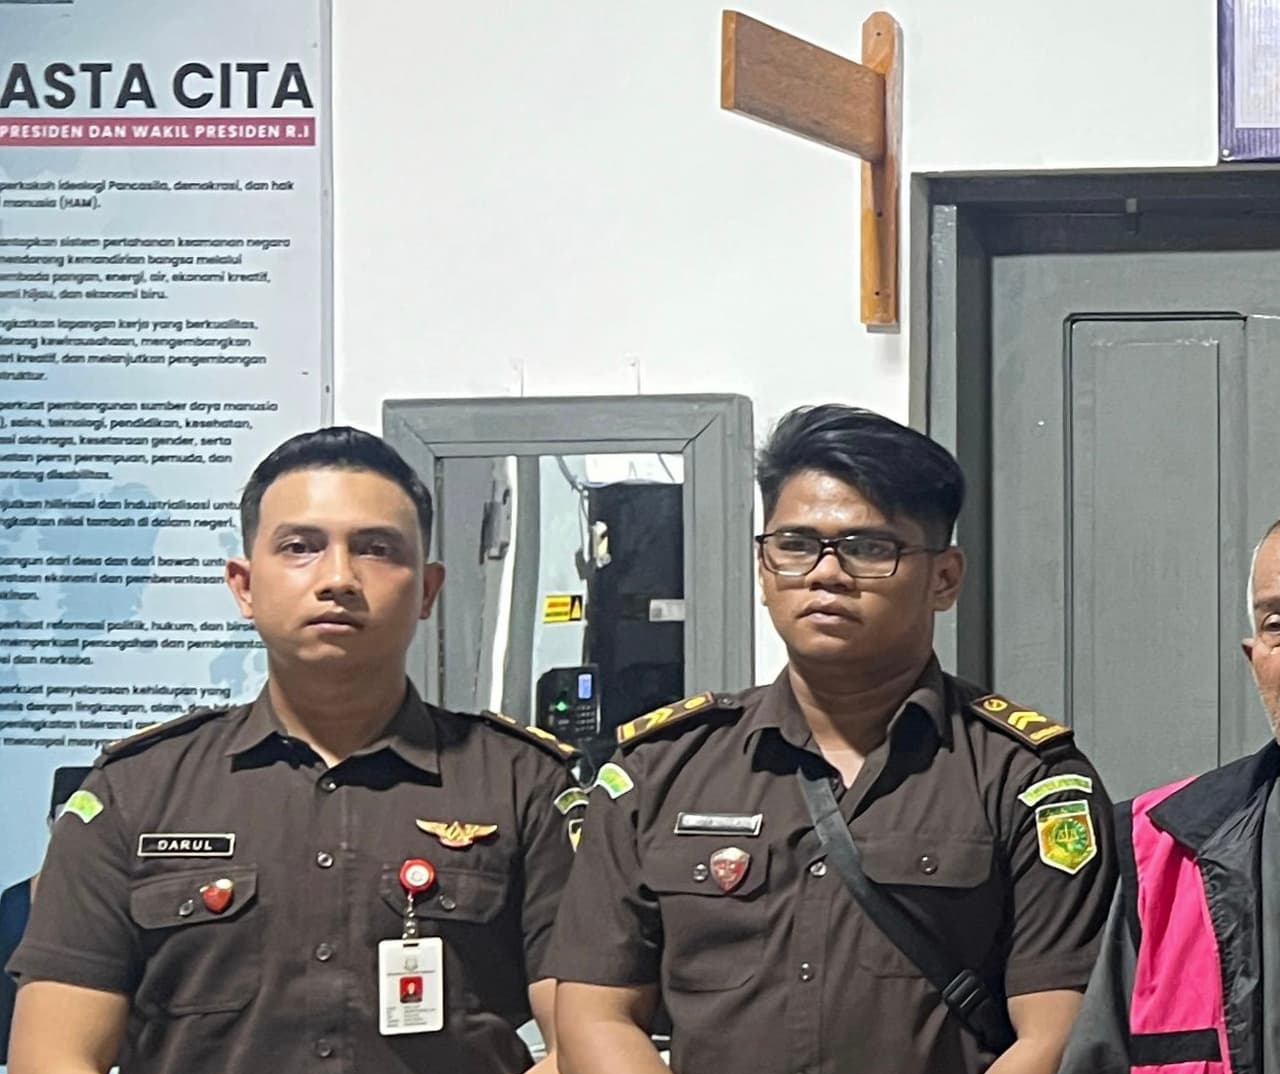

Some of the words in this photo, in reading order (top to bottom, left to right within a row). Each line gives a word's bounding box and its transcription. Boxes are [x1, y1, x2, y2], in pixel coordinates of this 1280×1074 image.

[1, 62, 157, 108] ASTA
[172, 62, 314, 108] CITA
[0, 125, 82, 139] PRESIDEN
[89, 125, 126, 139] DAN
[133, 125, 190, 139] WAKIL
[196, 125, 278, 139] PRESIDEN
[157, 839, 213, 852] DARUL
